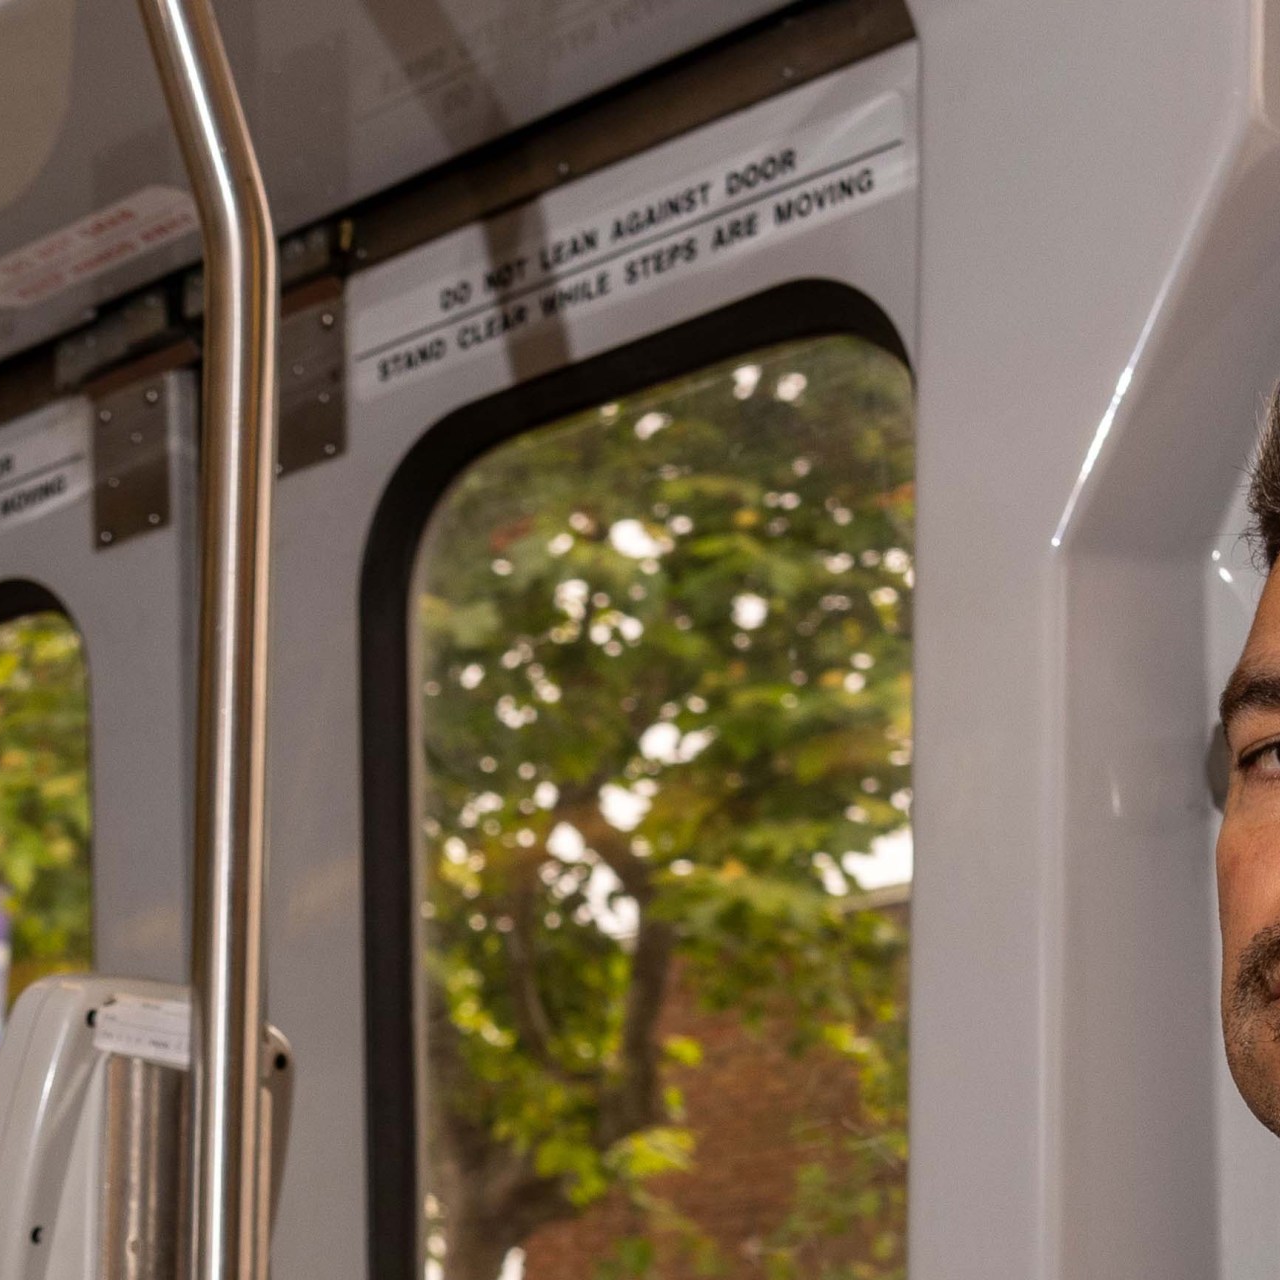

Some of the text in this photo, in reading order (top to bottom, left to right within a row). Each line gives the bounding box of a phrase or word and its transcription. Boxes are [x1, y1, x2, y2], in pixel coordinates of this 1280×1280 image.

[376, 169, 876, 382] STAND CLEAR WHILE STEPS ARE MOVING
[440, 149, 798, 310] DO NOT LEAN AGAINST DOOR
